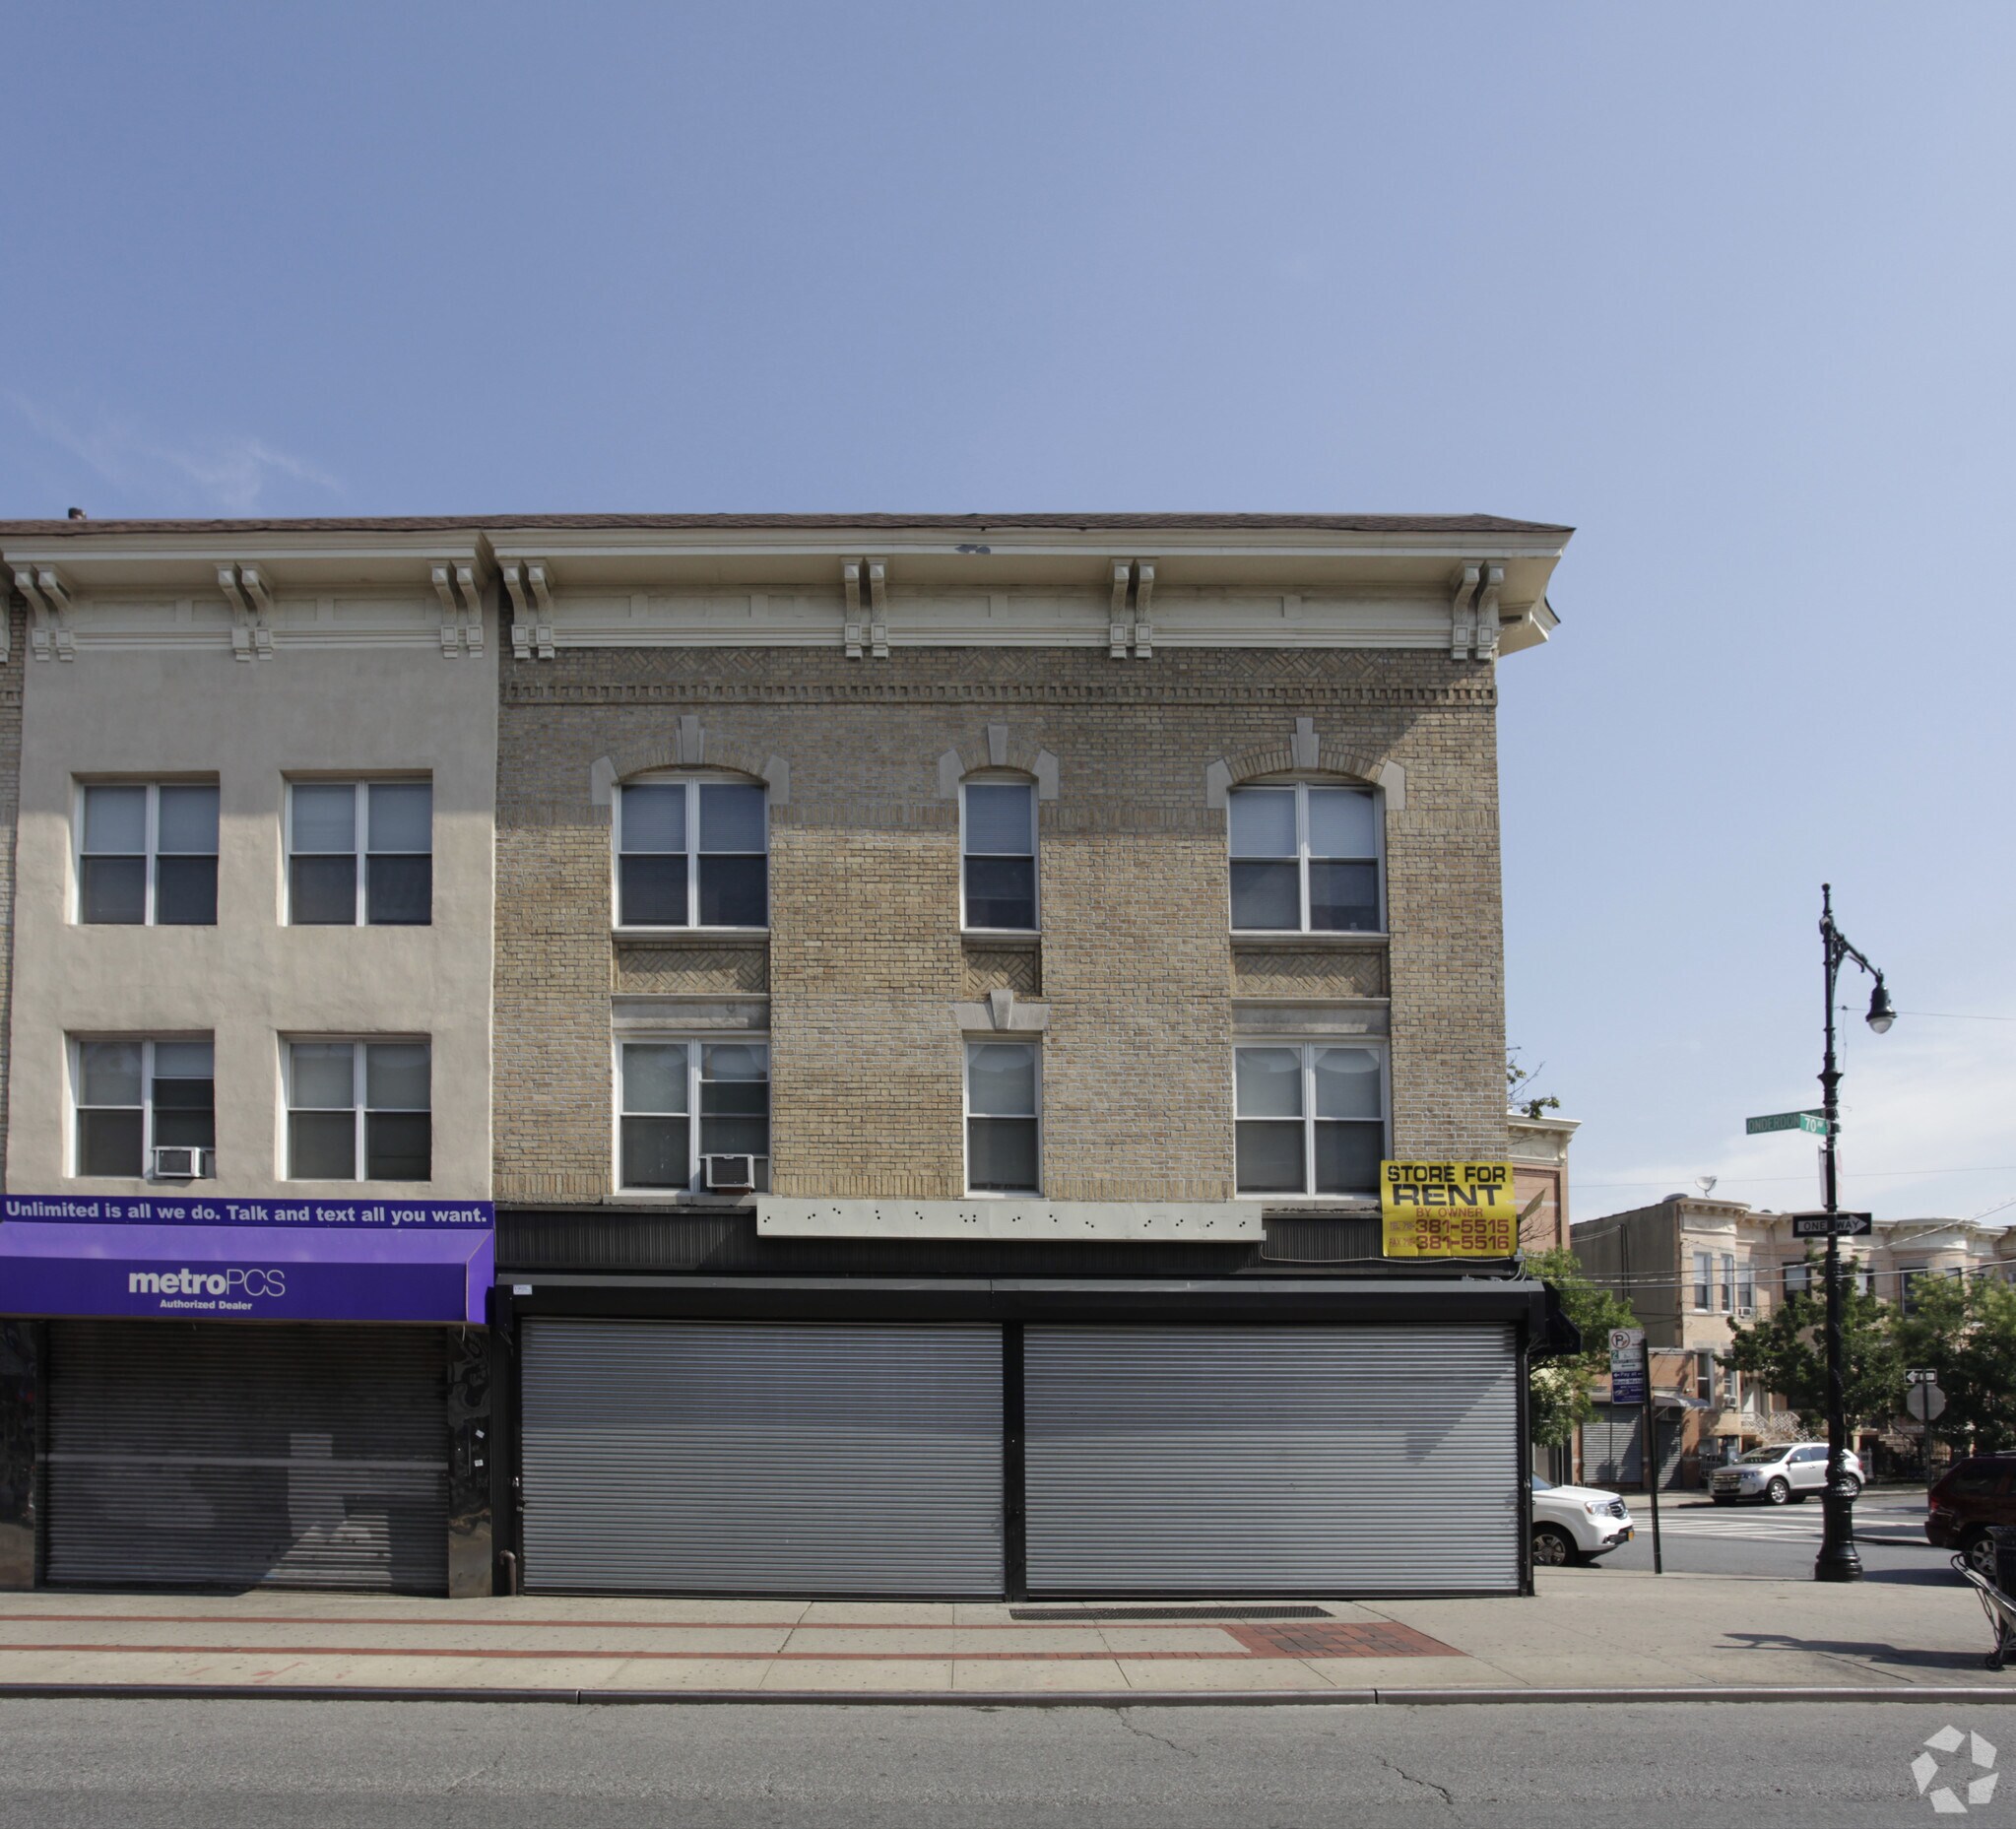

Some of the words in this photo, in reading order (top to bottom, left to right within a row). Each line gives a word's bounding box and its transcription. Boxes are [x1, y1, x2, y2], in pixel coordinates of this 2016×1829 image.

[1748, 1115, 1800, 1133] ONDERDON
[1804, 1117, 1817, 1133] 70
[1388, 1165, 1456, 1183] STORE
[1465, 1165, 1506, 1183] FOR
[1393, 1184, 1503, 1207] RENT
[6, 1201, 99, 1217] Unlimited
[104, 1203, 122, 1218] is
[127, 1203, 152, 1218] all
[157, 1208, 186, 1219] we
[191, 1204, 221, 1220] do.
[226, 1205, 269, 1221] Talk
[274, 1206, 310, 1221] and
[315, 1207, 356, 1222] text
[360, 1207, 385, 1222] all
[390, 1209, 426, 1225] you
[431, 1207, 488, 1223] want.
[1416, 1208, 1432, 1217] BY
[1438, 1208, 1483, 1217] OWNER
[1803, 1220, 1826, 1231] ONE
[1836, 1219, 1860, 1230] WAY
[128, 1268, 286, 1297] metroPCS
[160, 1298, 216, 1310] Authorized
[218, 1300, 253, 1311] Dealer
